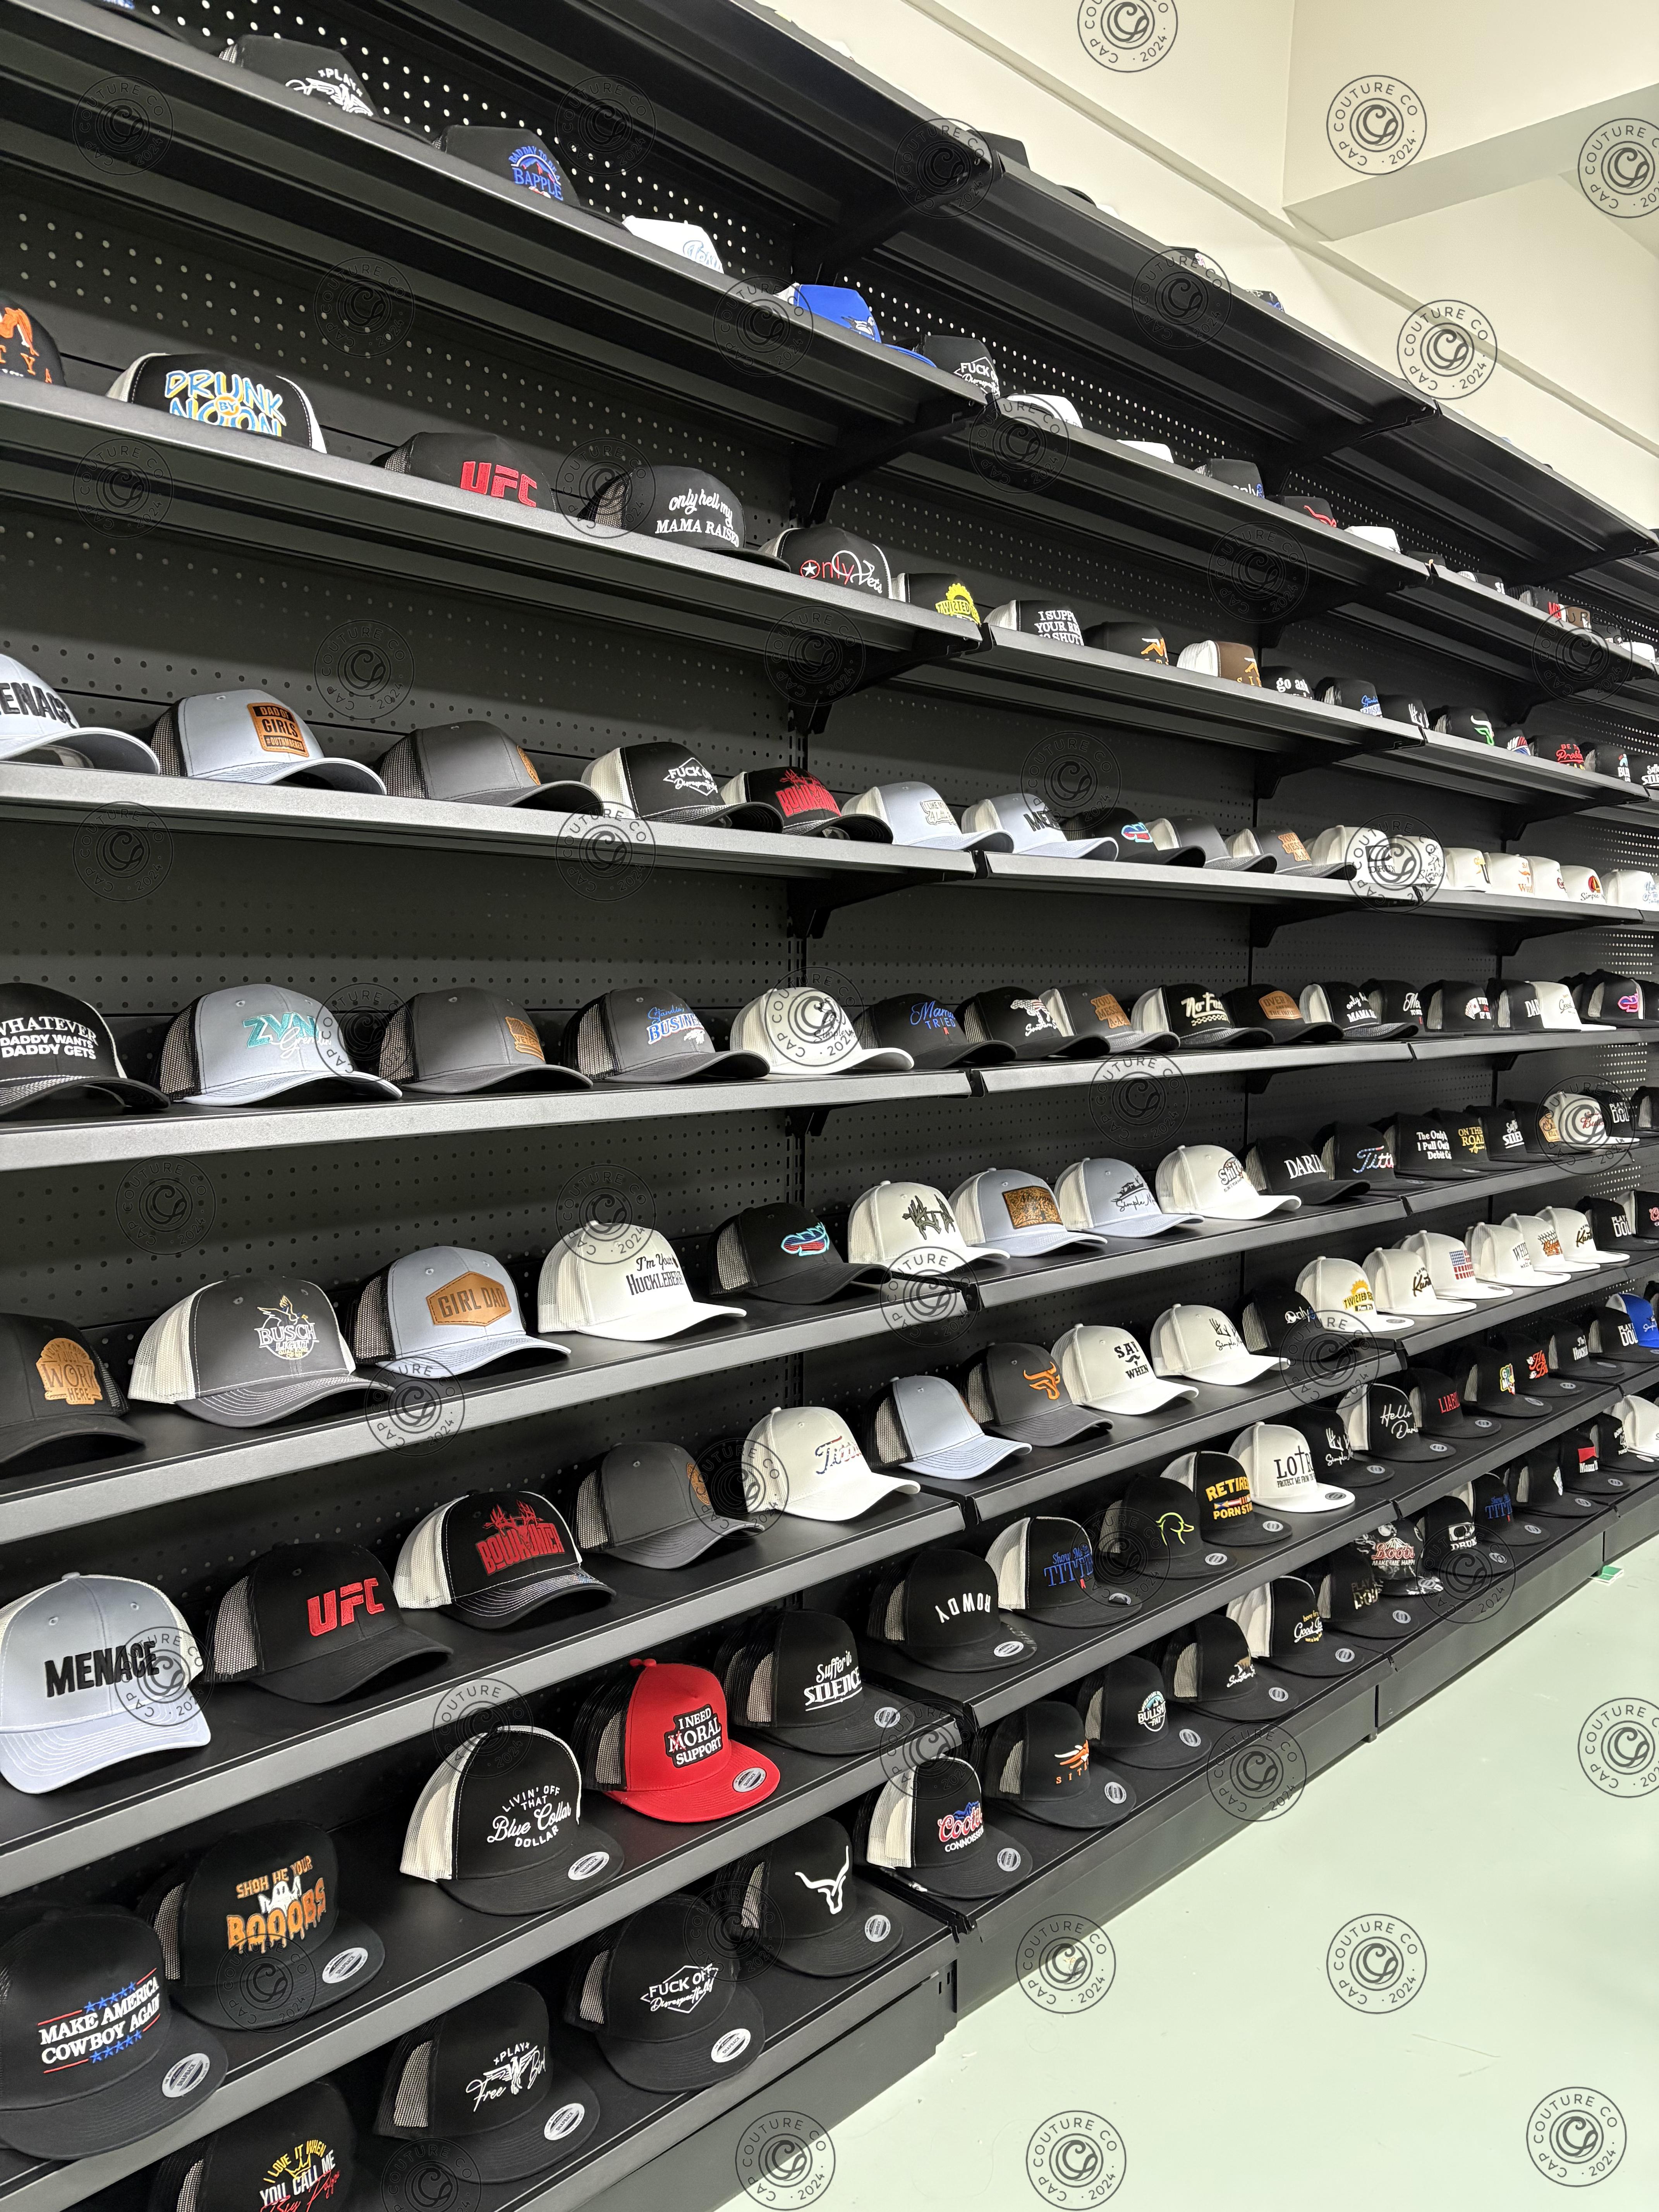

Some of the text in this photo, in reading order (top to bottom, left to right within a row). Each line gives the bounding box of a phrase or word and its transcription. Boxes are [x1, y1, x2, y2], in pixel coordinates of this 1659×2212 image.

[961, 362, 989, 377] FUCK
[165, 370, 287, 426] DRUNK
[219, 401, 236, 412] BY
[460, 461, 538, 507] UFC
[669, 489, 698, 515] only
[655, 519, 702, 534] MAMA
[1034, 621, 1067, 633] YOUR
[1276, 677, 1291, 692] go
[261, 707, 280, 716] DAD
[262, 719, 298, 737] GIRLS
[668, 766, 702, 779] FUCK
[925, 1017, 956, 1030] TRIED
[0, 1034, 94, 1049] DADDY WANTS
[1, 1044, 96, 1060] DADDY GETS
[1417, 1132, 1430, 1141] The
[1458, 1128, 1470, 1137] ON
[1422, 1141, 1436, 1151] Pull
[1116, 1195, 1145, 1212] Simple
[636, 1256, 656, 1271] I'm
[437, 1287, 507, 1318] GIRL DAD
[256, 1324, 317, 1346] BUSCH
[41, 1363, 98, 1388] WORK
[1125, 1364, 1149, 1379] WHEN
[67, 1388, 91, 1401] HERE
[1380, 1403, 1412, 1427] Hello
[307, 1577, 385, 1637] UFC
[935, 1592, 991, 1623] ROWDY
[46, 1640, 160, 1698] MENACE
[816, 1656, 845, 1683] Suffer
[678, 1707, 712, 1730] I NEED
[676, 1736, 722, 1766] SUPPORT
[502, 1785, 561, 1813] LIVIN' OFF
[520, 1795, 547, 1811] THAT
[486, 1802, 572, 1843] Blue Collar
[514, 1826, 560, 1848] DOLLAR
[226, 1877, 326, 1954] BOOOBS
[649, 1963, 713, 1998] FUCK OFF
[40, 1977, 159, 2045] MAKE AMERICA
[41, 1994, 160, 2064] COWBOY AGAIN
[500, 2043, 525, 2061] PLAY
[465, 2079, 507, 2111] Free
[267, 2154, 291, 2177] LOVE
[294, 2144, 303, 2160] IT
[306, 2139, 327, 2157] WHEN
[259, 2150, 336, 2208] YOU CALL ME
